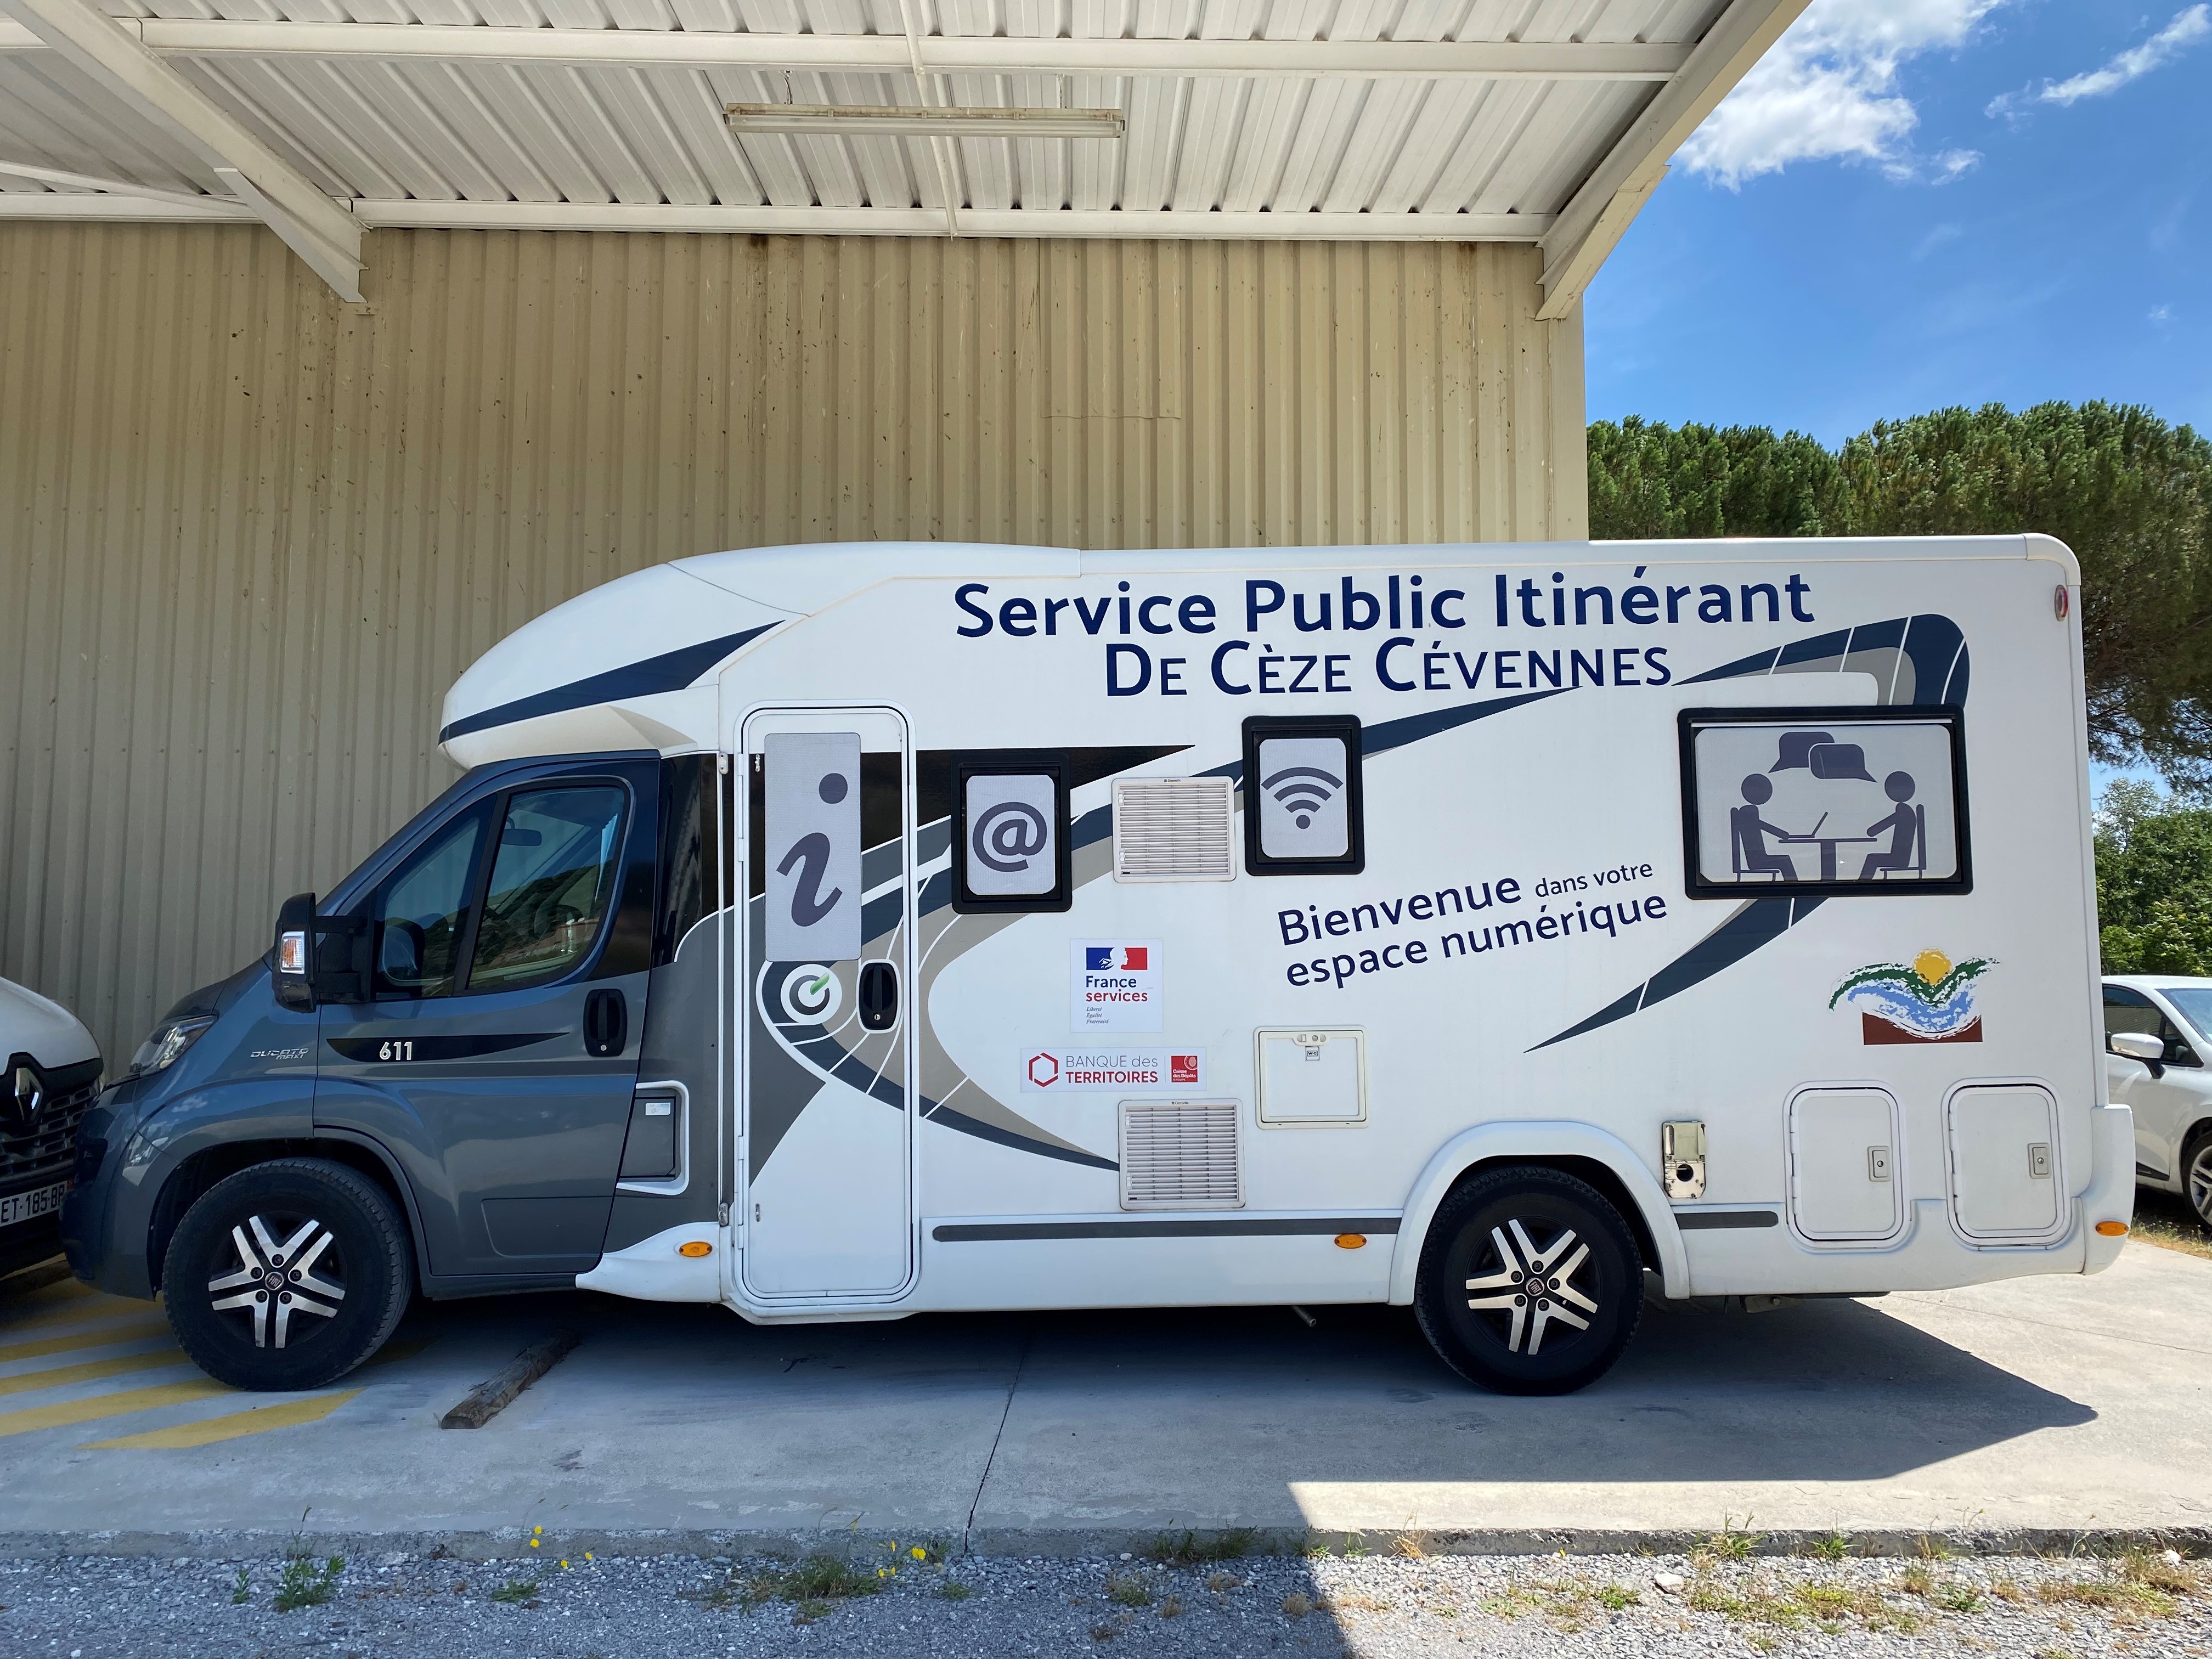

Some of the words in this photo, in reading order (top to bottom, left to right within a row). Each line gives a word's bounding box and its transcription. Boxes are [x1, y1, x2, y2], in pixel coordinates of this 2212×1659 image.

[955, 581, 1216, 637] Service
[1246, 575, 1466, 632] Public
[1496, 566, 1815, 628] Itinérant
[1106, 644, 1187, 696] DE
[1211, 640, 1351, 695] CÈZE
[1376, 637, 1671, 691] CÉVENNES
[1278, 878, 1521, 946] Bienvenue
[1536, 876, 1588, 897] dans
[1593, 864, 1653, 885] votre
[1287, 927, 1428, 989] espace
[1441, 896, 1667, 958] numérique
[1086, 975, 1137, 988] France
[1086, 989, 1148, 1002] services
[250, 1048, 309, 1058] DUCATO
[380, 1041, 413, 1060] 611
[1066, 1055, 1127, 1069] BANQUE
[1131, 1055, 1158, 1068] des
[1065, 1071, 1158, 1084] TERRITOIRES
[268, 1276, 280, 1288] FIAT
[1529, 1281, 1542, 1294] FIAT
